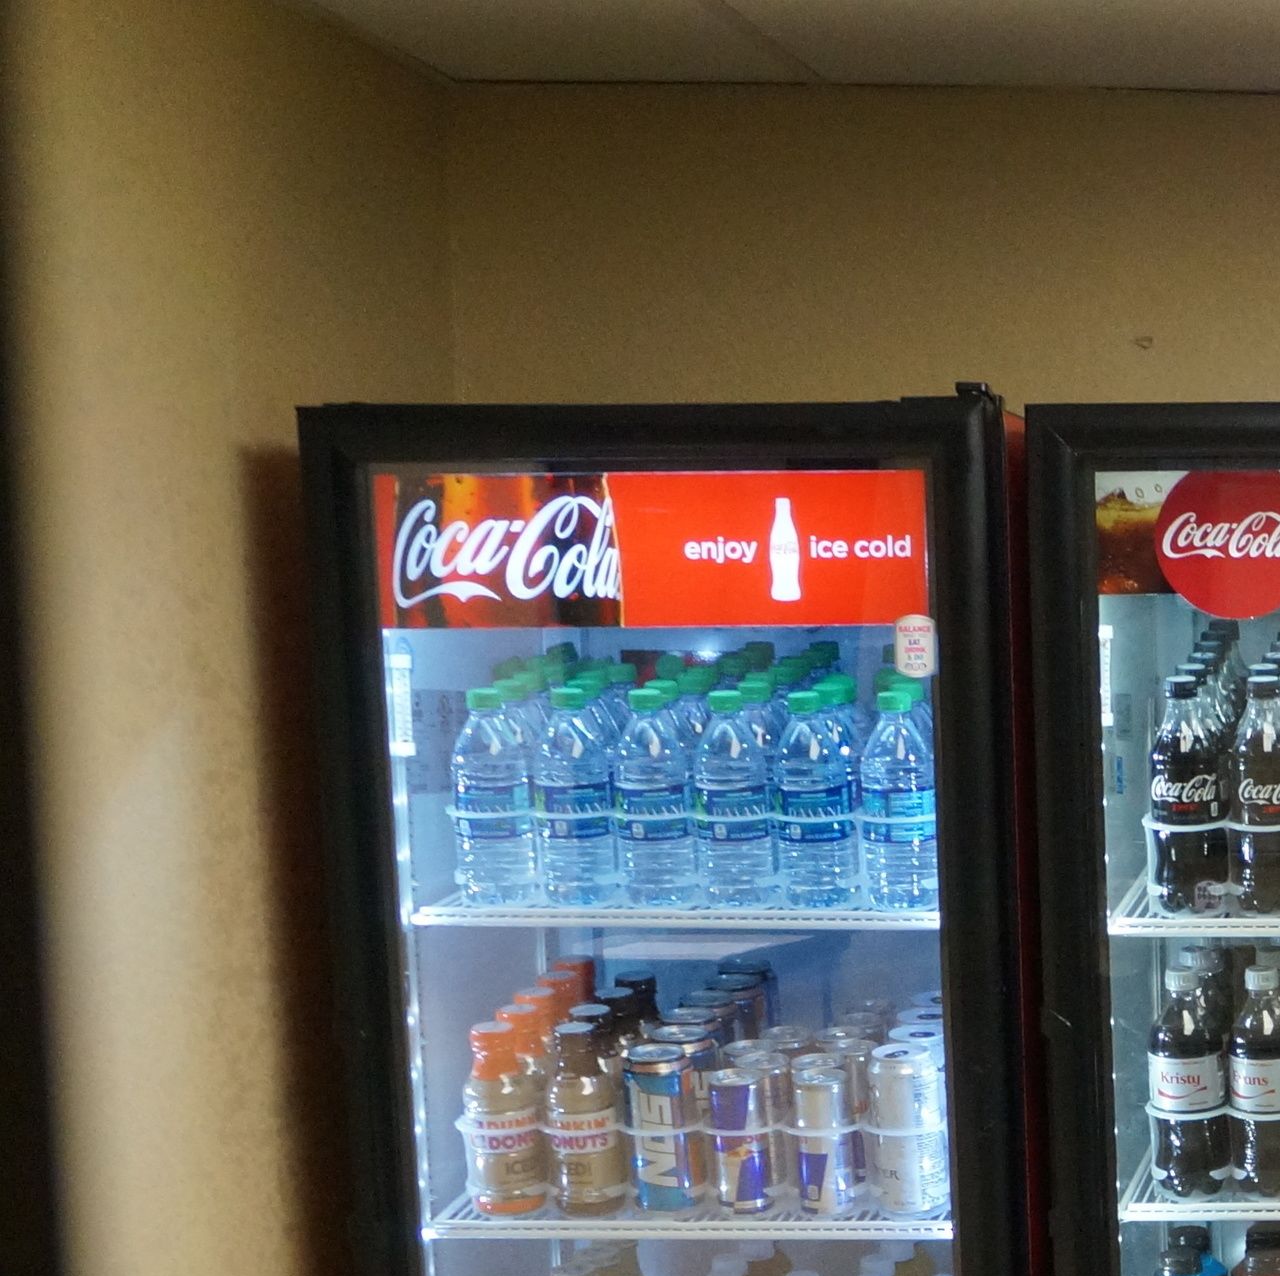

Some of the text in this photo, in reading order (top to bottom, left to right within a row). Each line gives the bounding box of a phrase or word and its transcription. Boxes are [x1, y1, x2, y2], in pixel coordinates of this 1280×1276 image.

[392, 495, 621, 609] Coca-Cola
[684, 535, 912, 564] enjoy ice cold
[1151, 773, 1217, 803] Coca-Cola
[1160, 1071, 1200, 1087] Kristy
